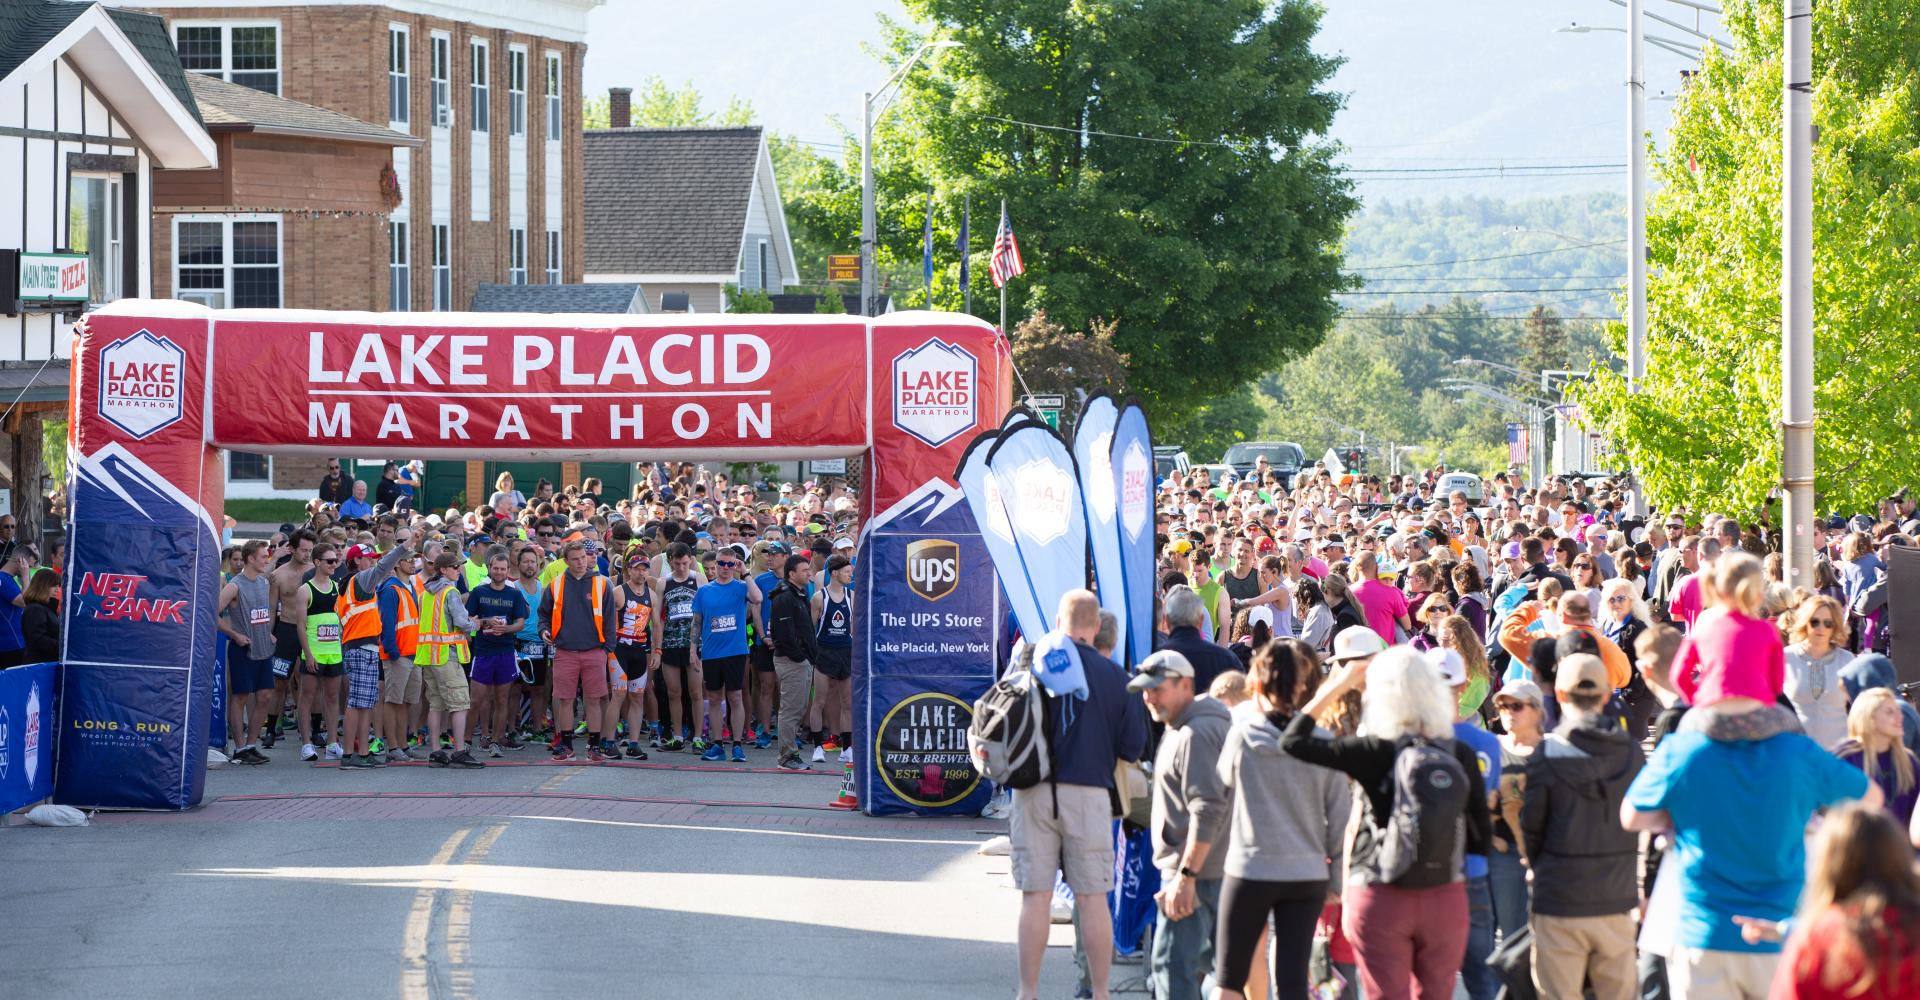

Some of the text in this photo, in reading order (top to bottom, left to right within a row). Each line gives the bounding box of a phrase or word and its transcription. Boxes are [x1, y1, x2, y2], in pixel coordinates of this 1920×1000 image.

[22, 260, 86, 293] MAIN STREET PIZZA
[308, 331, 771, 386] LAKE PLACID
[108, 362, 175, 383] LAKE
[902, 371, 969, 390] LAKE
[107, 381, 175, 398] PLACID
[902, 391, 969, 405] PLACID
[107, 400, 175, 409] MARATHON
[308, 401, 771, 440] MARATHON
[80, 571, 148, 597] NBT
[910, 558, 956, 592] ups
[94, 596, 188, 624] BANK
[881, 613, 907, 627] The
[911, 613, 940, 627] UPS
[875, 642, 990, 654] Lake Placid, New York
[910, 705, 956, 727] LAKE
[74, 719, 170, 733] LONG RUN
[119, 734, 162, 742] Advisors
[900, 728, 966, 750] PLACID
[886, 753, 973, 763] PUB & BREWER
[894, 769, 969, 779] EST. 1996
